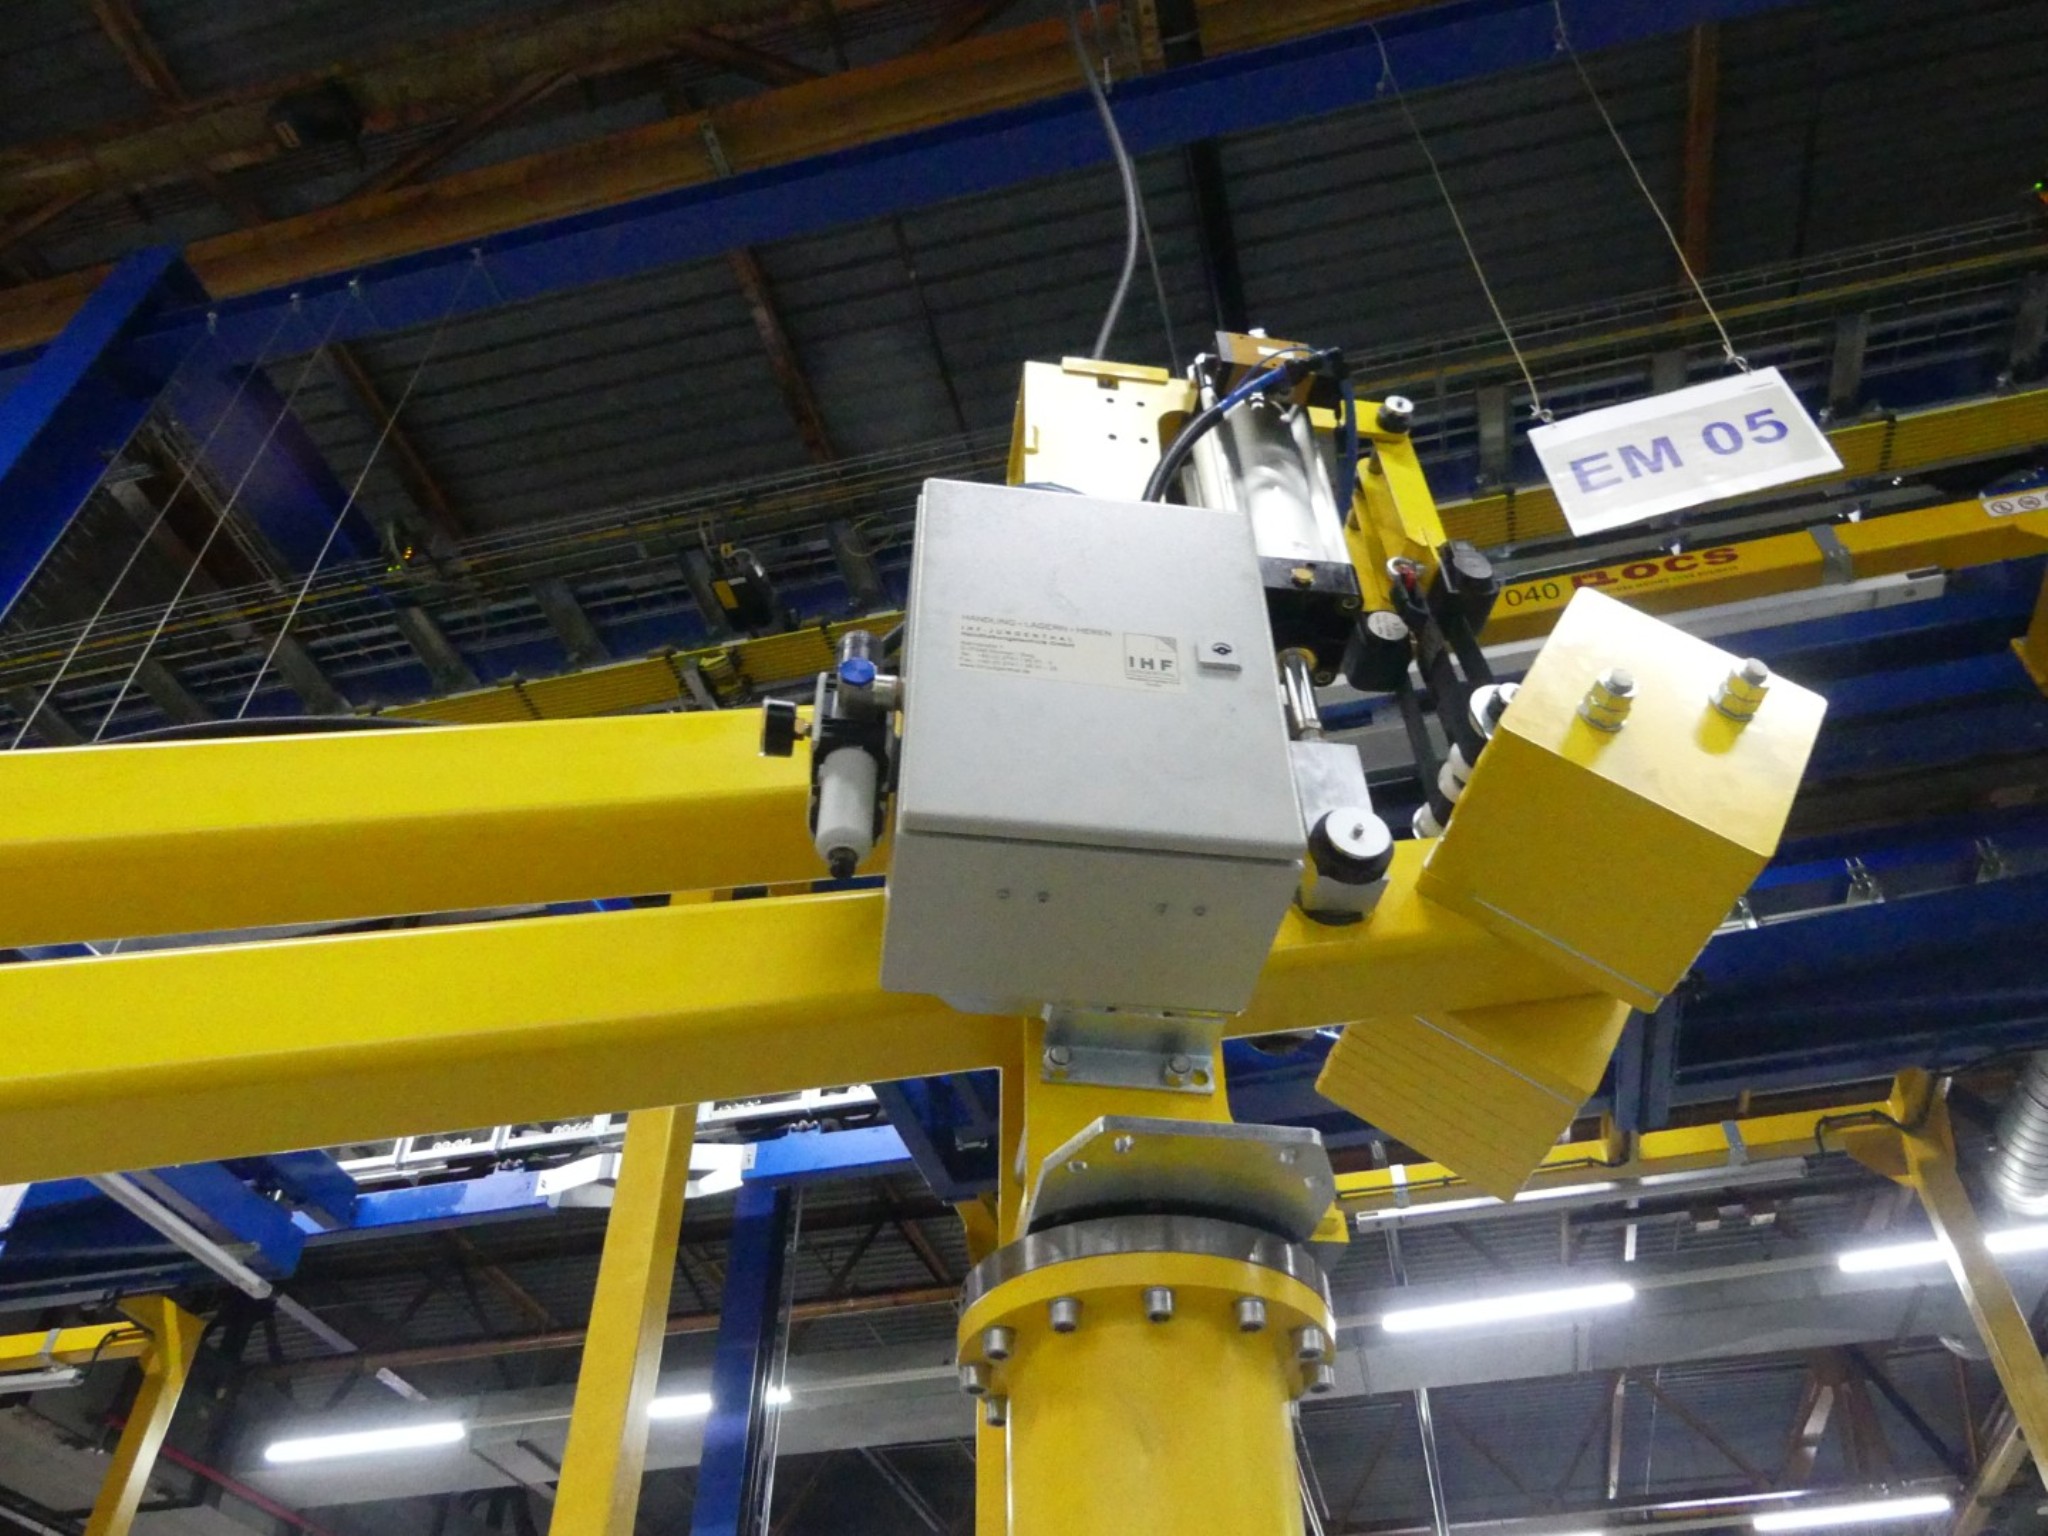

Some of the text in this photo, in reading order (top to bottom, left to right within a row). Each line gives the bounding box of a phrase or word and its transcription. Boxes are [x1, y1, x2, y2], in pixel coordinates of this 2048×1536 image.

[1569, 408, 1788, 494] EM 05
[1504, 582, 1560, 607] 040
[1128, 655, 1173, 671] IHF
